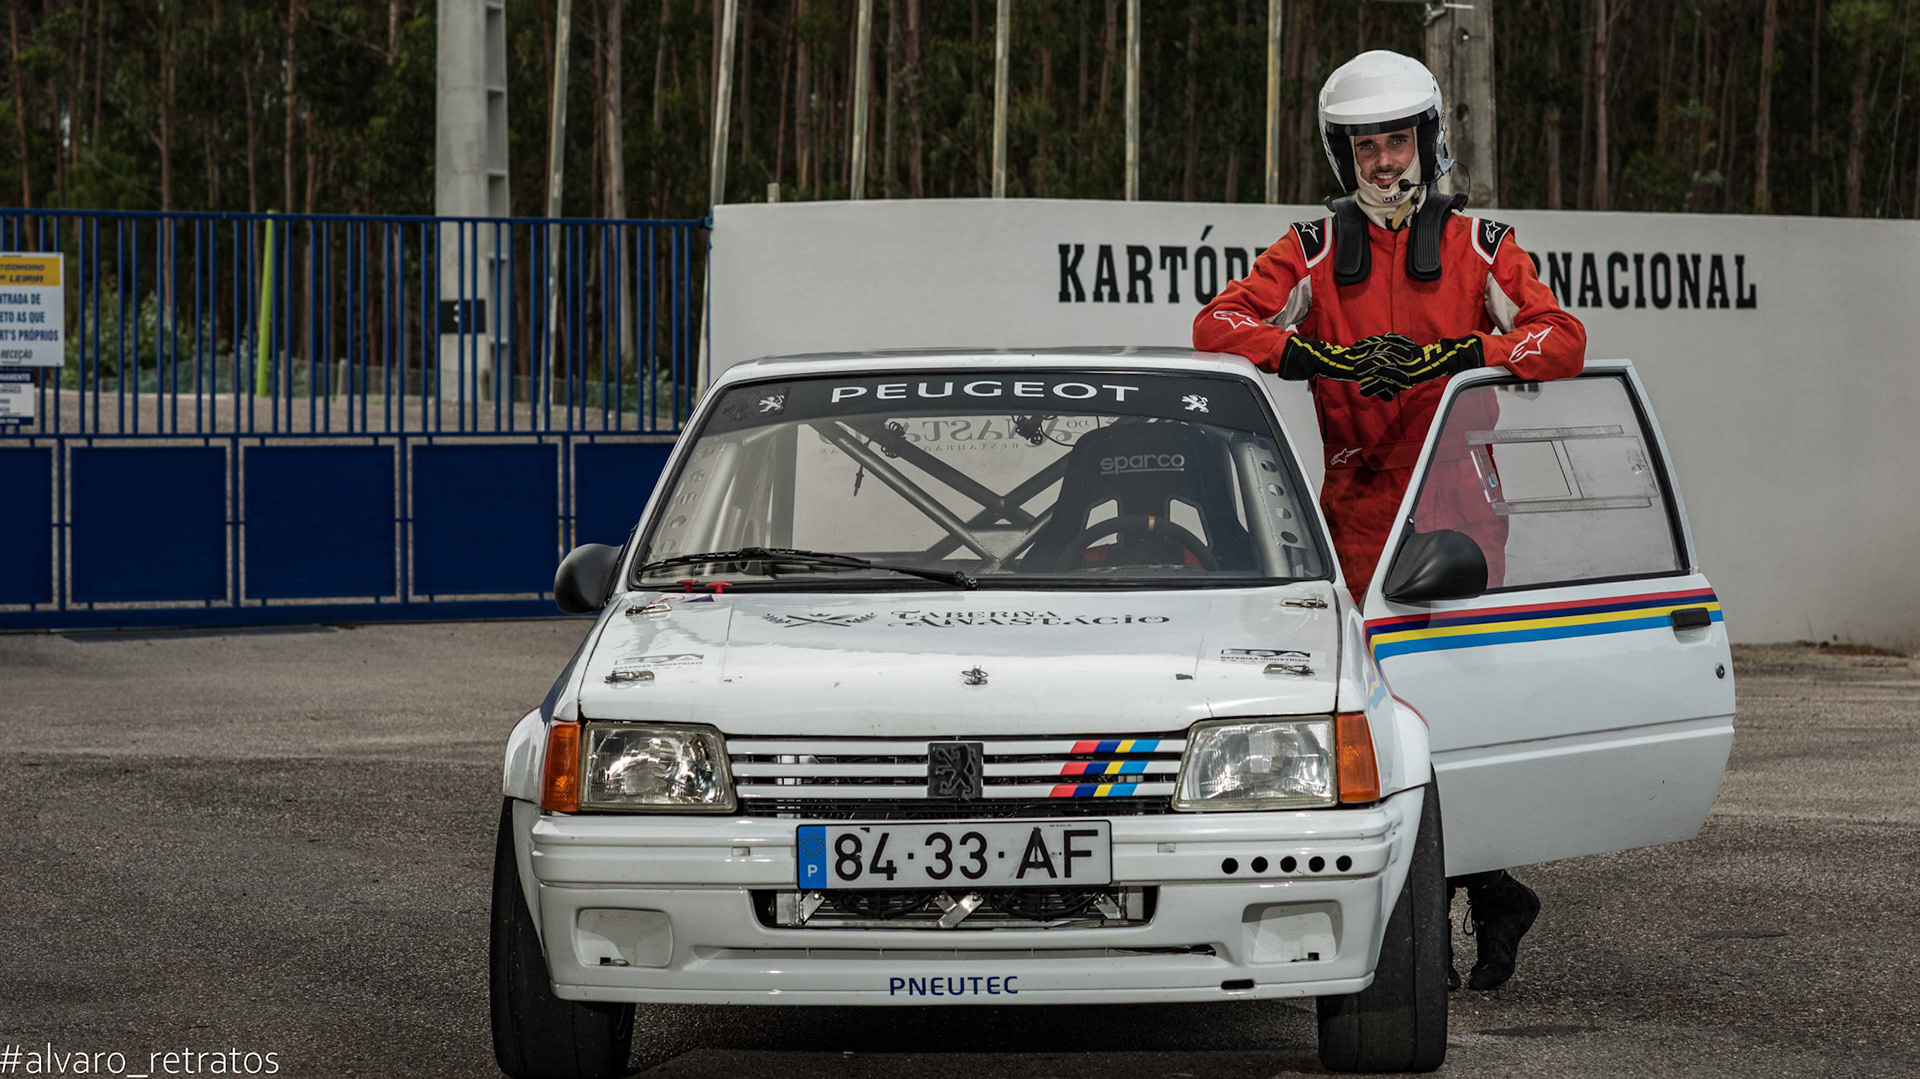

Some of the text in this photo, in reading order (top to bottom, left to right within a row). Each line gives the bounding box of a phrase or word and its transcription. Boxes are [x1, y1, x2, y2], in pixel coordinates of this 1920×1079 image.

[1058, 225, 1757, 310] KARTÓD NACIONAL
[31, 293, 41, 305] DE
[17, 311, 27, 323] AS
[29, 311, 45, 324] QUE
[18, 327, 59, 342] PRÓPRIOS
[831, 381, 1139, 403] PEUGEOT
[1101, 453, 1186, 475] sparco
[890, 610, 1059, 620] TABERNA
[807, 865, 818, 877] P
[889, 976, 1019, 996] PNEUTEC
